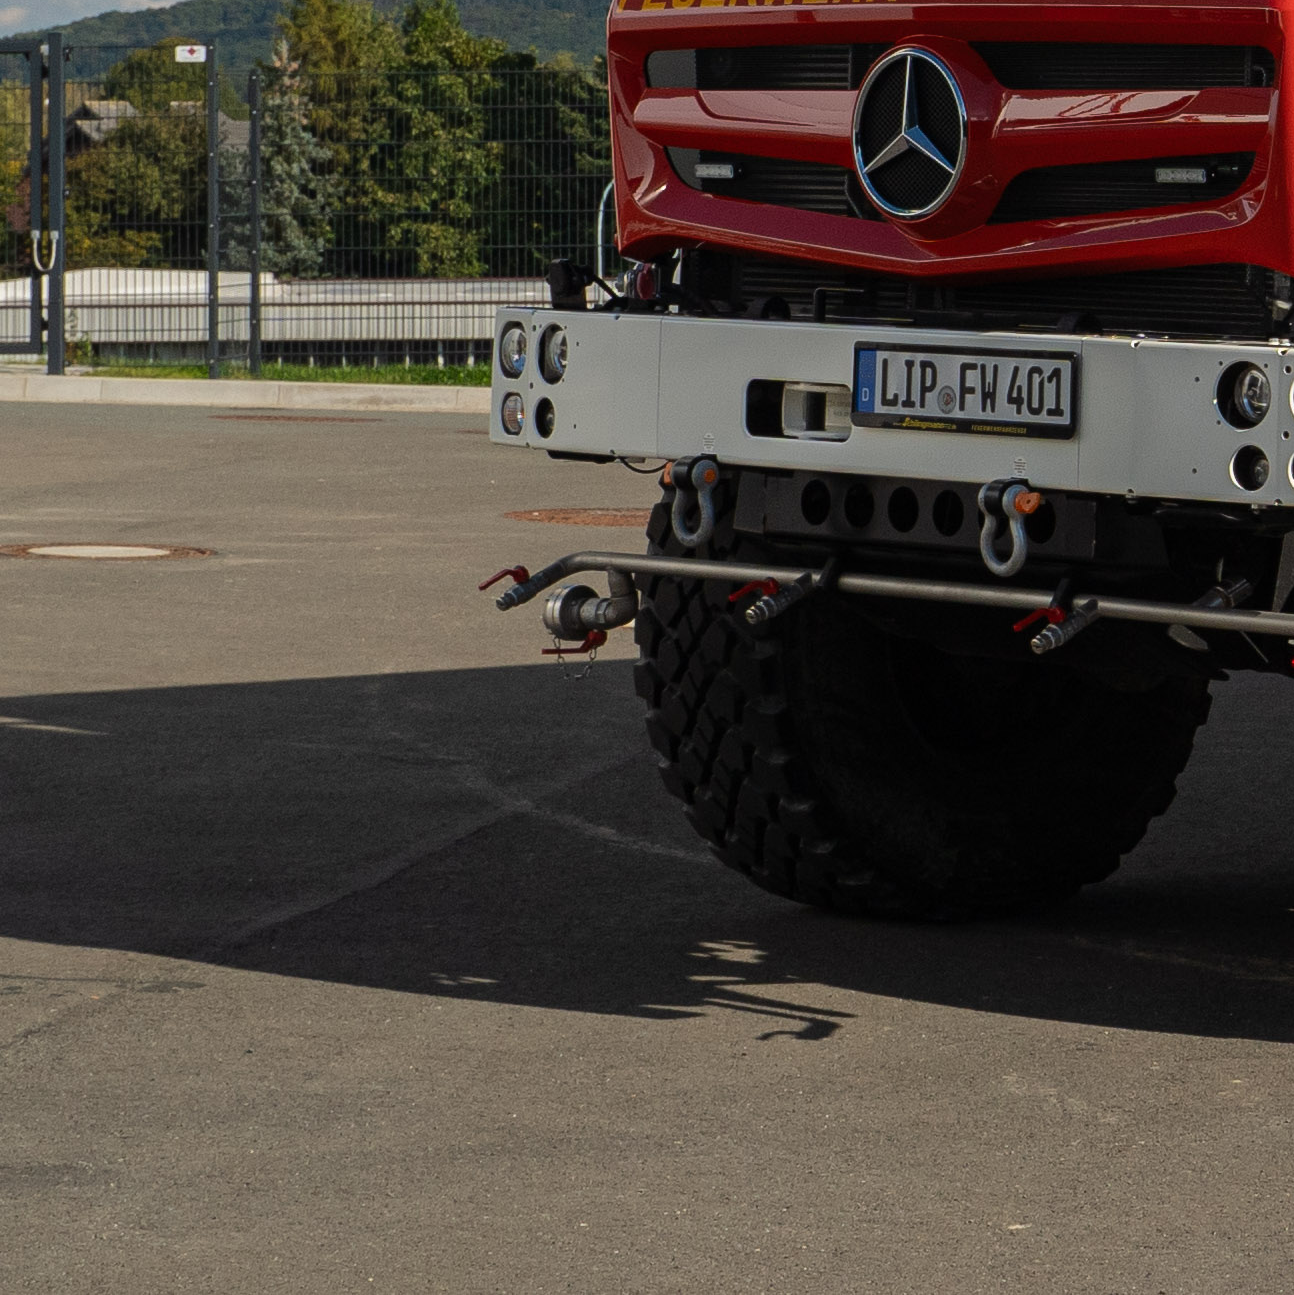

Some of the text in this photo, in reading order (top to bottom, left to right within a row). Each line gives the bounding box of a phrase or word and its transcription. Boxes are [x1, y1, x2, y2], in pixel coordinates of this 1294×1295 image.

[861, 387, 870, 403] D
[880, 357, 938, 409] LIP
[958, 362, 999, 414] FW
[1007, 365, 1065, 418] 401
